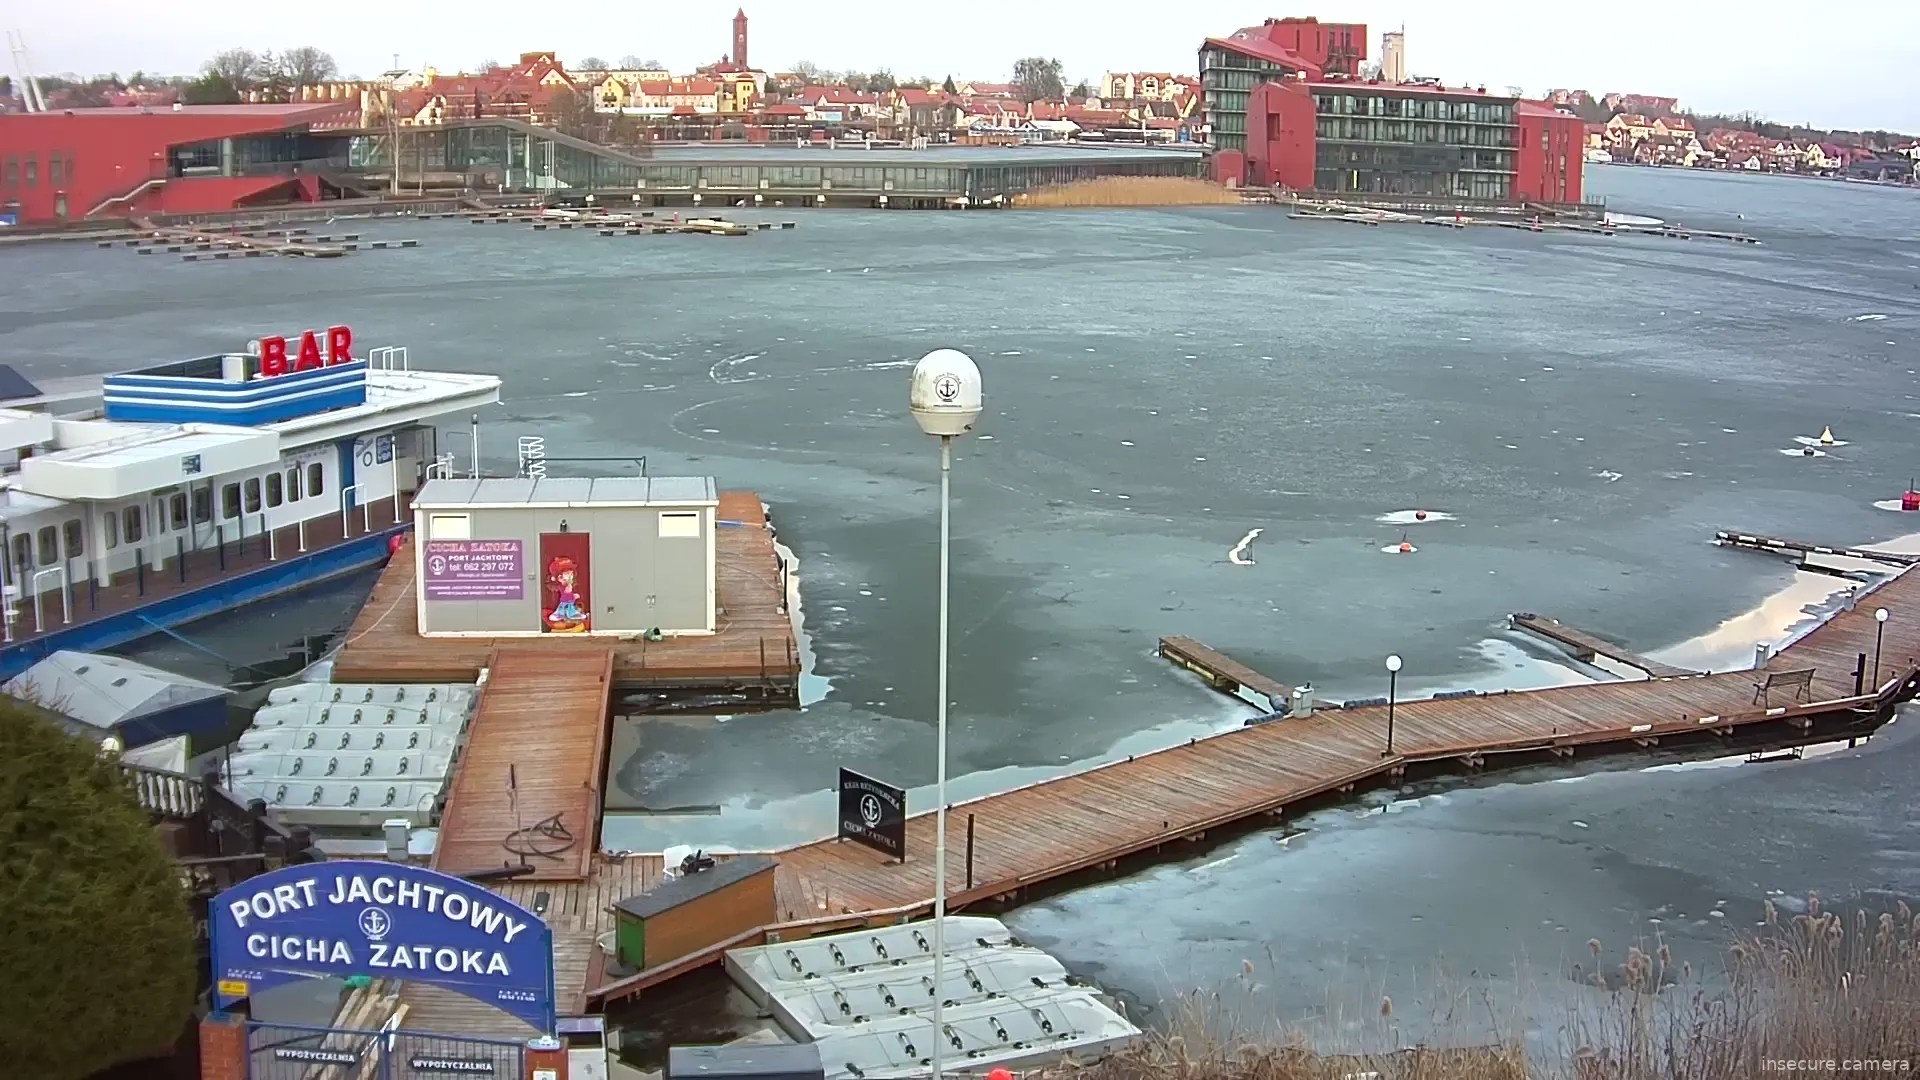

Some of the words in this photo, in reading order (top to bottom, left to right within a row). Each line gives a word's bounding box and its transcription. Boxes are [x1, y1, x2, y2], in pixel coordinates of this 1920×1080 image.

[260, 325, 352, 377] BAR
[428, 542, 467, 552] CICHA
[470, 542, 519, 552] ZATOKA
[463, 562, 480, 571] 662
[481, 562, 496, 571] 297
[498, 562, 514, 571] 072
[229, 879, 316, 928] PORT
[328, 876, 527, 944] JACHTOWY
[246, 934, 352, 965] CICHA
[368, 944, 510, 976] ZATOKA
[275, 1049, 355, 1062] WYPOŻYCZALNIA
[412, 1060, 493, 1071] WYPOŻYCZALNIA
